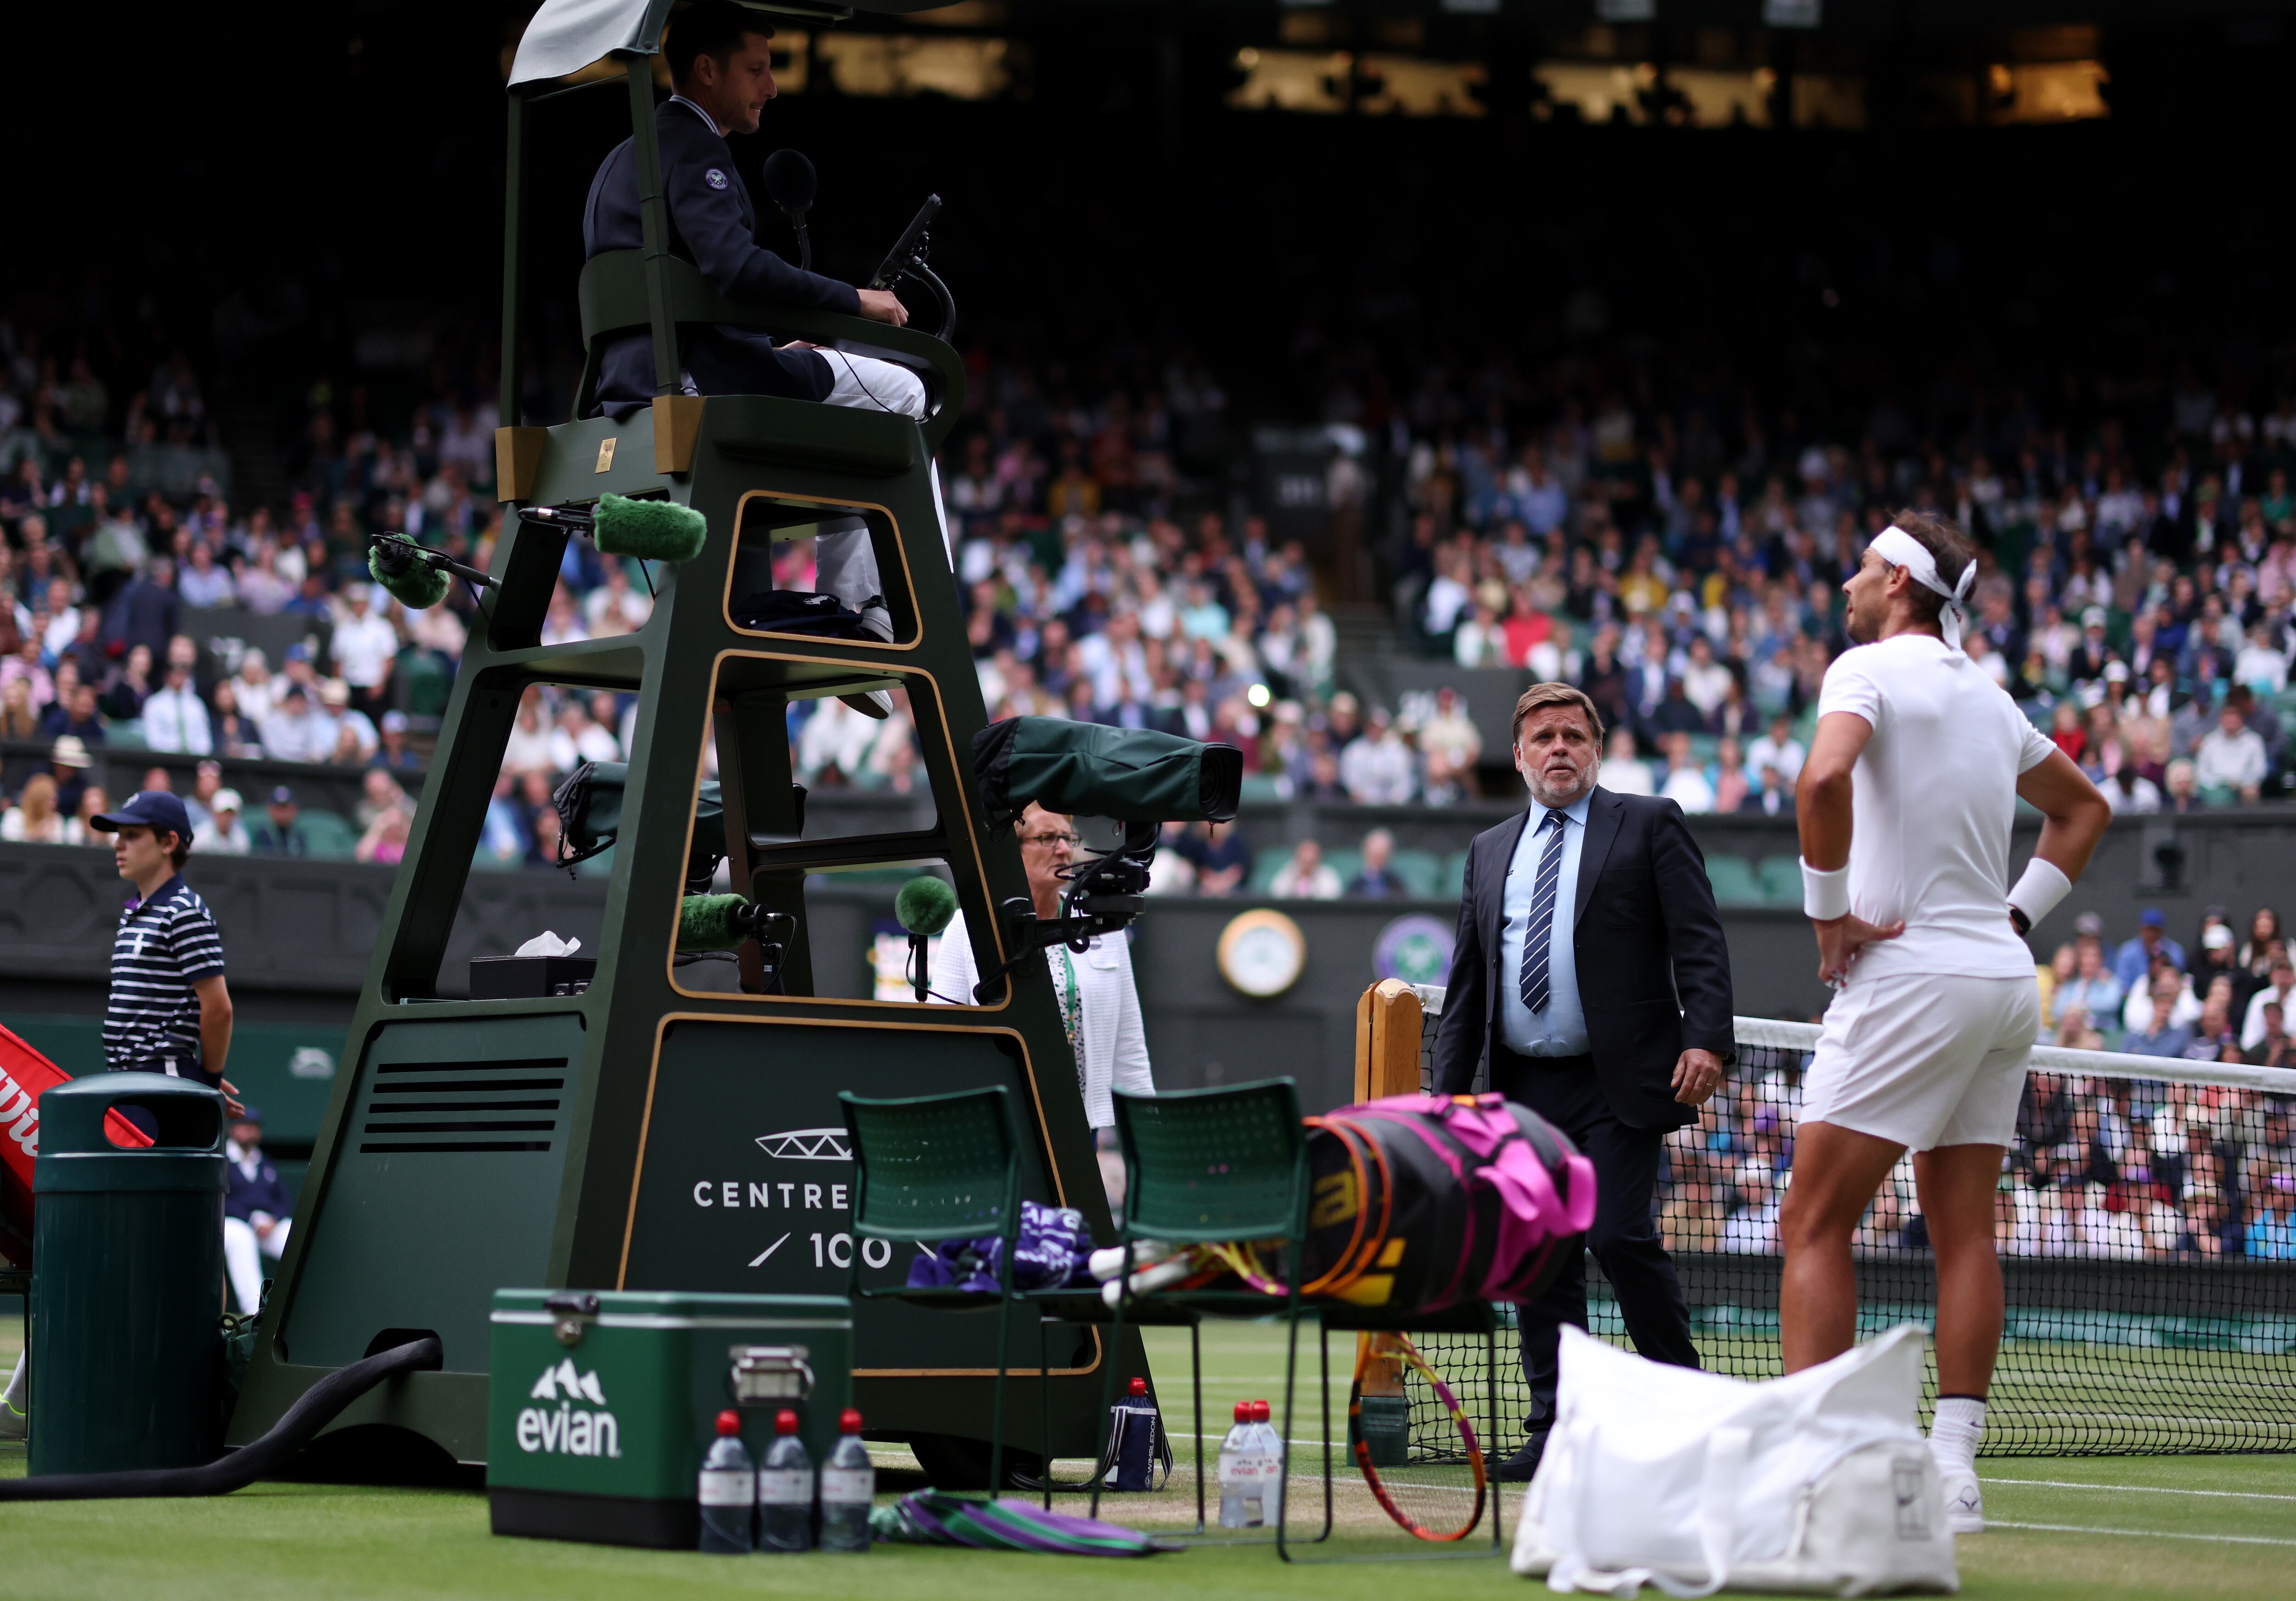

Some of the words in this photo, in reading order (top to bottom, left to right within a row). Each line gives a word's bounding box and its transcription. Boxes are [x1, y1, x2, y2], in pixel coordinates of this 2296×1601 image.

[693, 1181, 848, 1209] CENTRE
[810, 1233, 891, 1269] 100
[517, 1399, 618, 1457] evian
[1148, 1416, 1156, 1473] WIMBLEDON
[1231, 1466, 1258, 1476] evian
